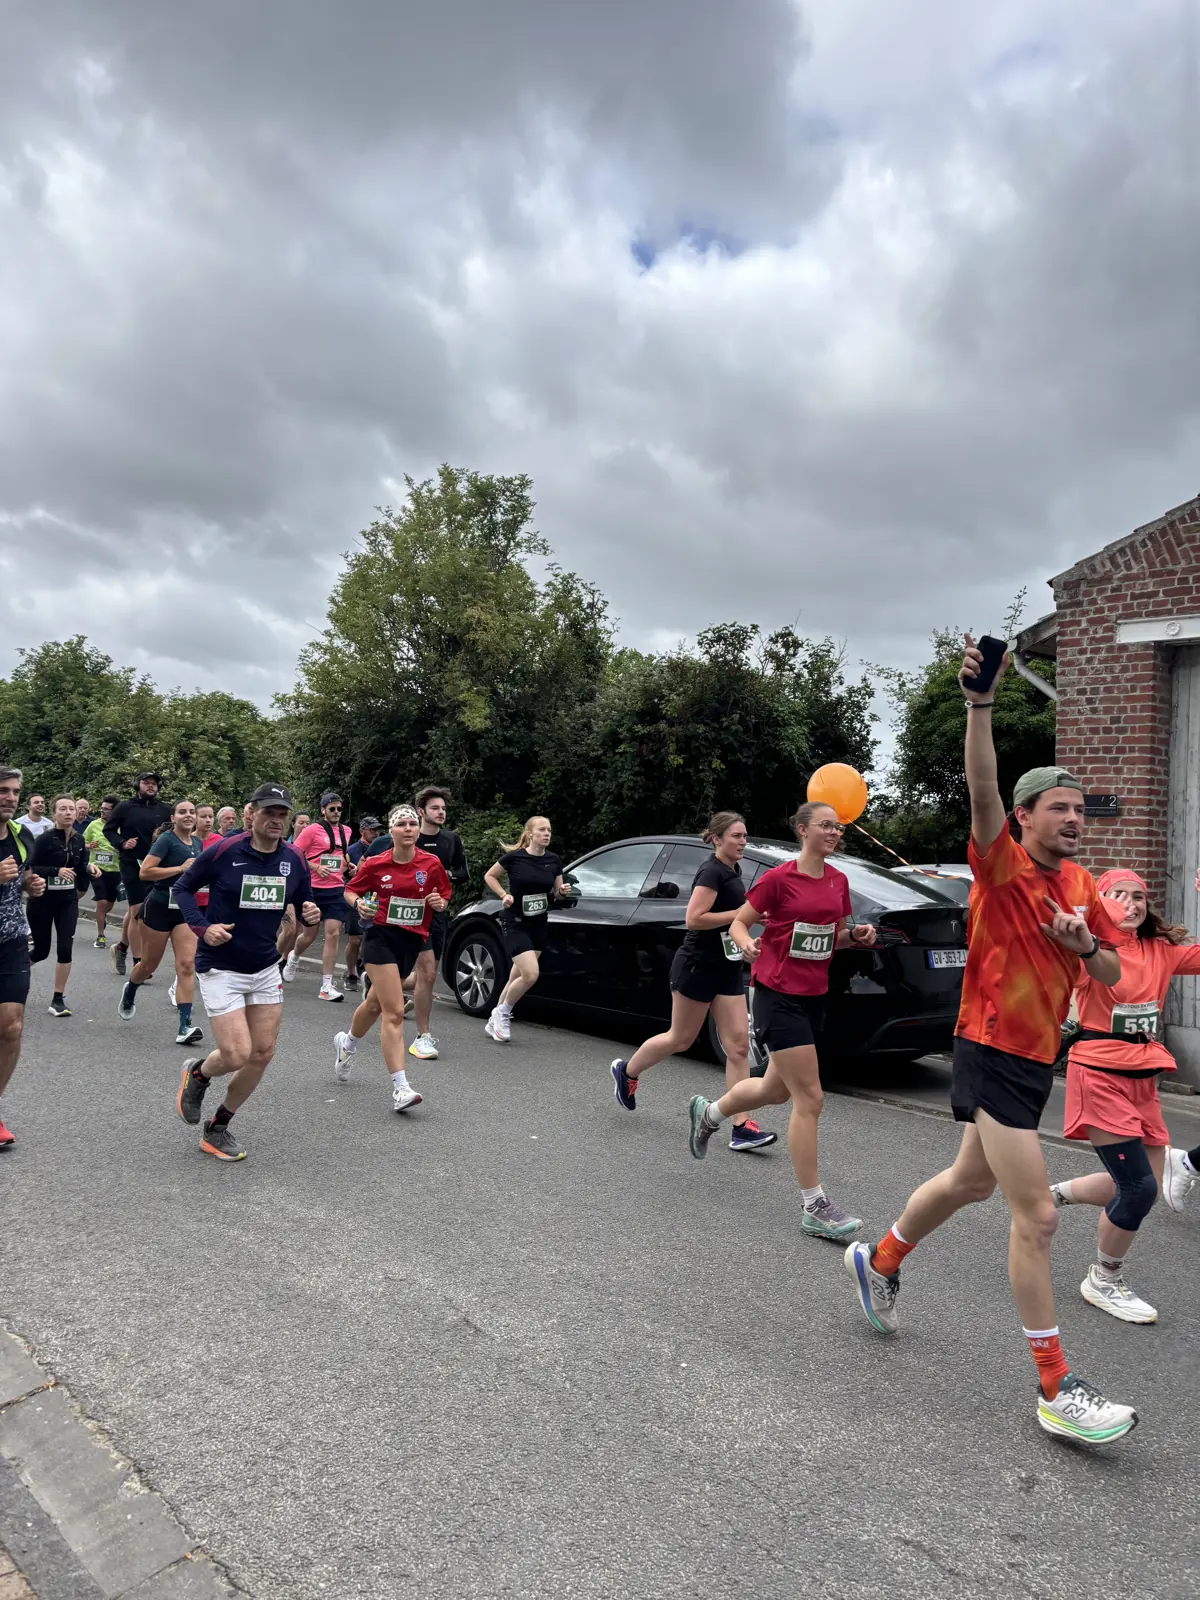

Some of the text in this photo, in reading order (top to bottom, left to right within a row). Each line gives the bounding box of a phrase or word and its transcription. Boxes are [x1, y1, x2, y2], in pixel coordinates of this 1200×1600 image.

[1109, 795, 1117, 807] 2
[249, 886, 278, 902] 404
[395, 906, 419, 920] 103
[528, 900, 544, 911] 263
[801, 936, 829, 952] 401
[1123, 1016, 1158, 1036] 537
